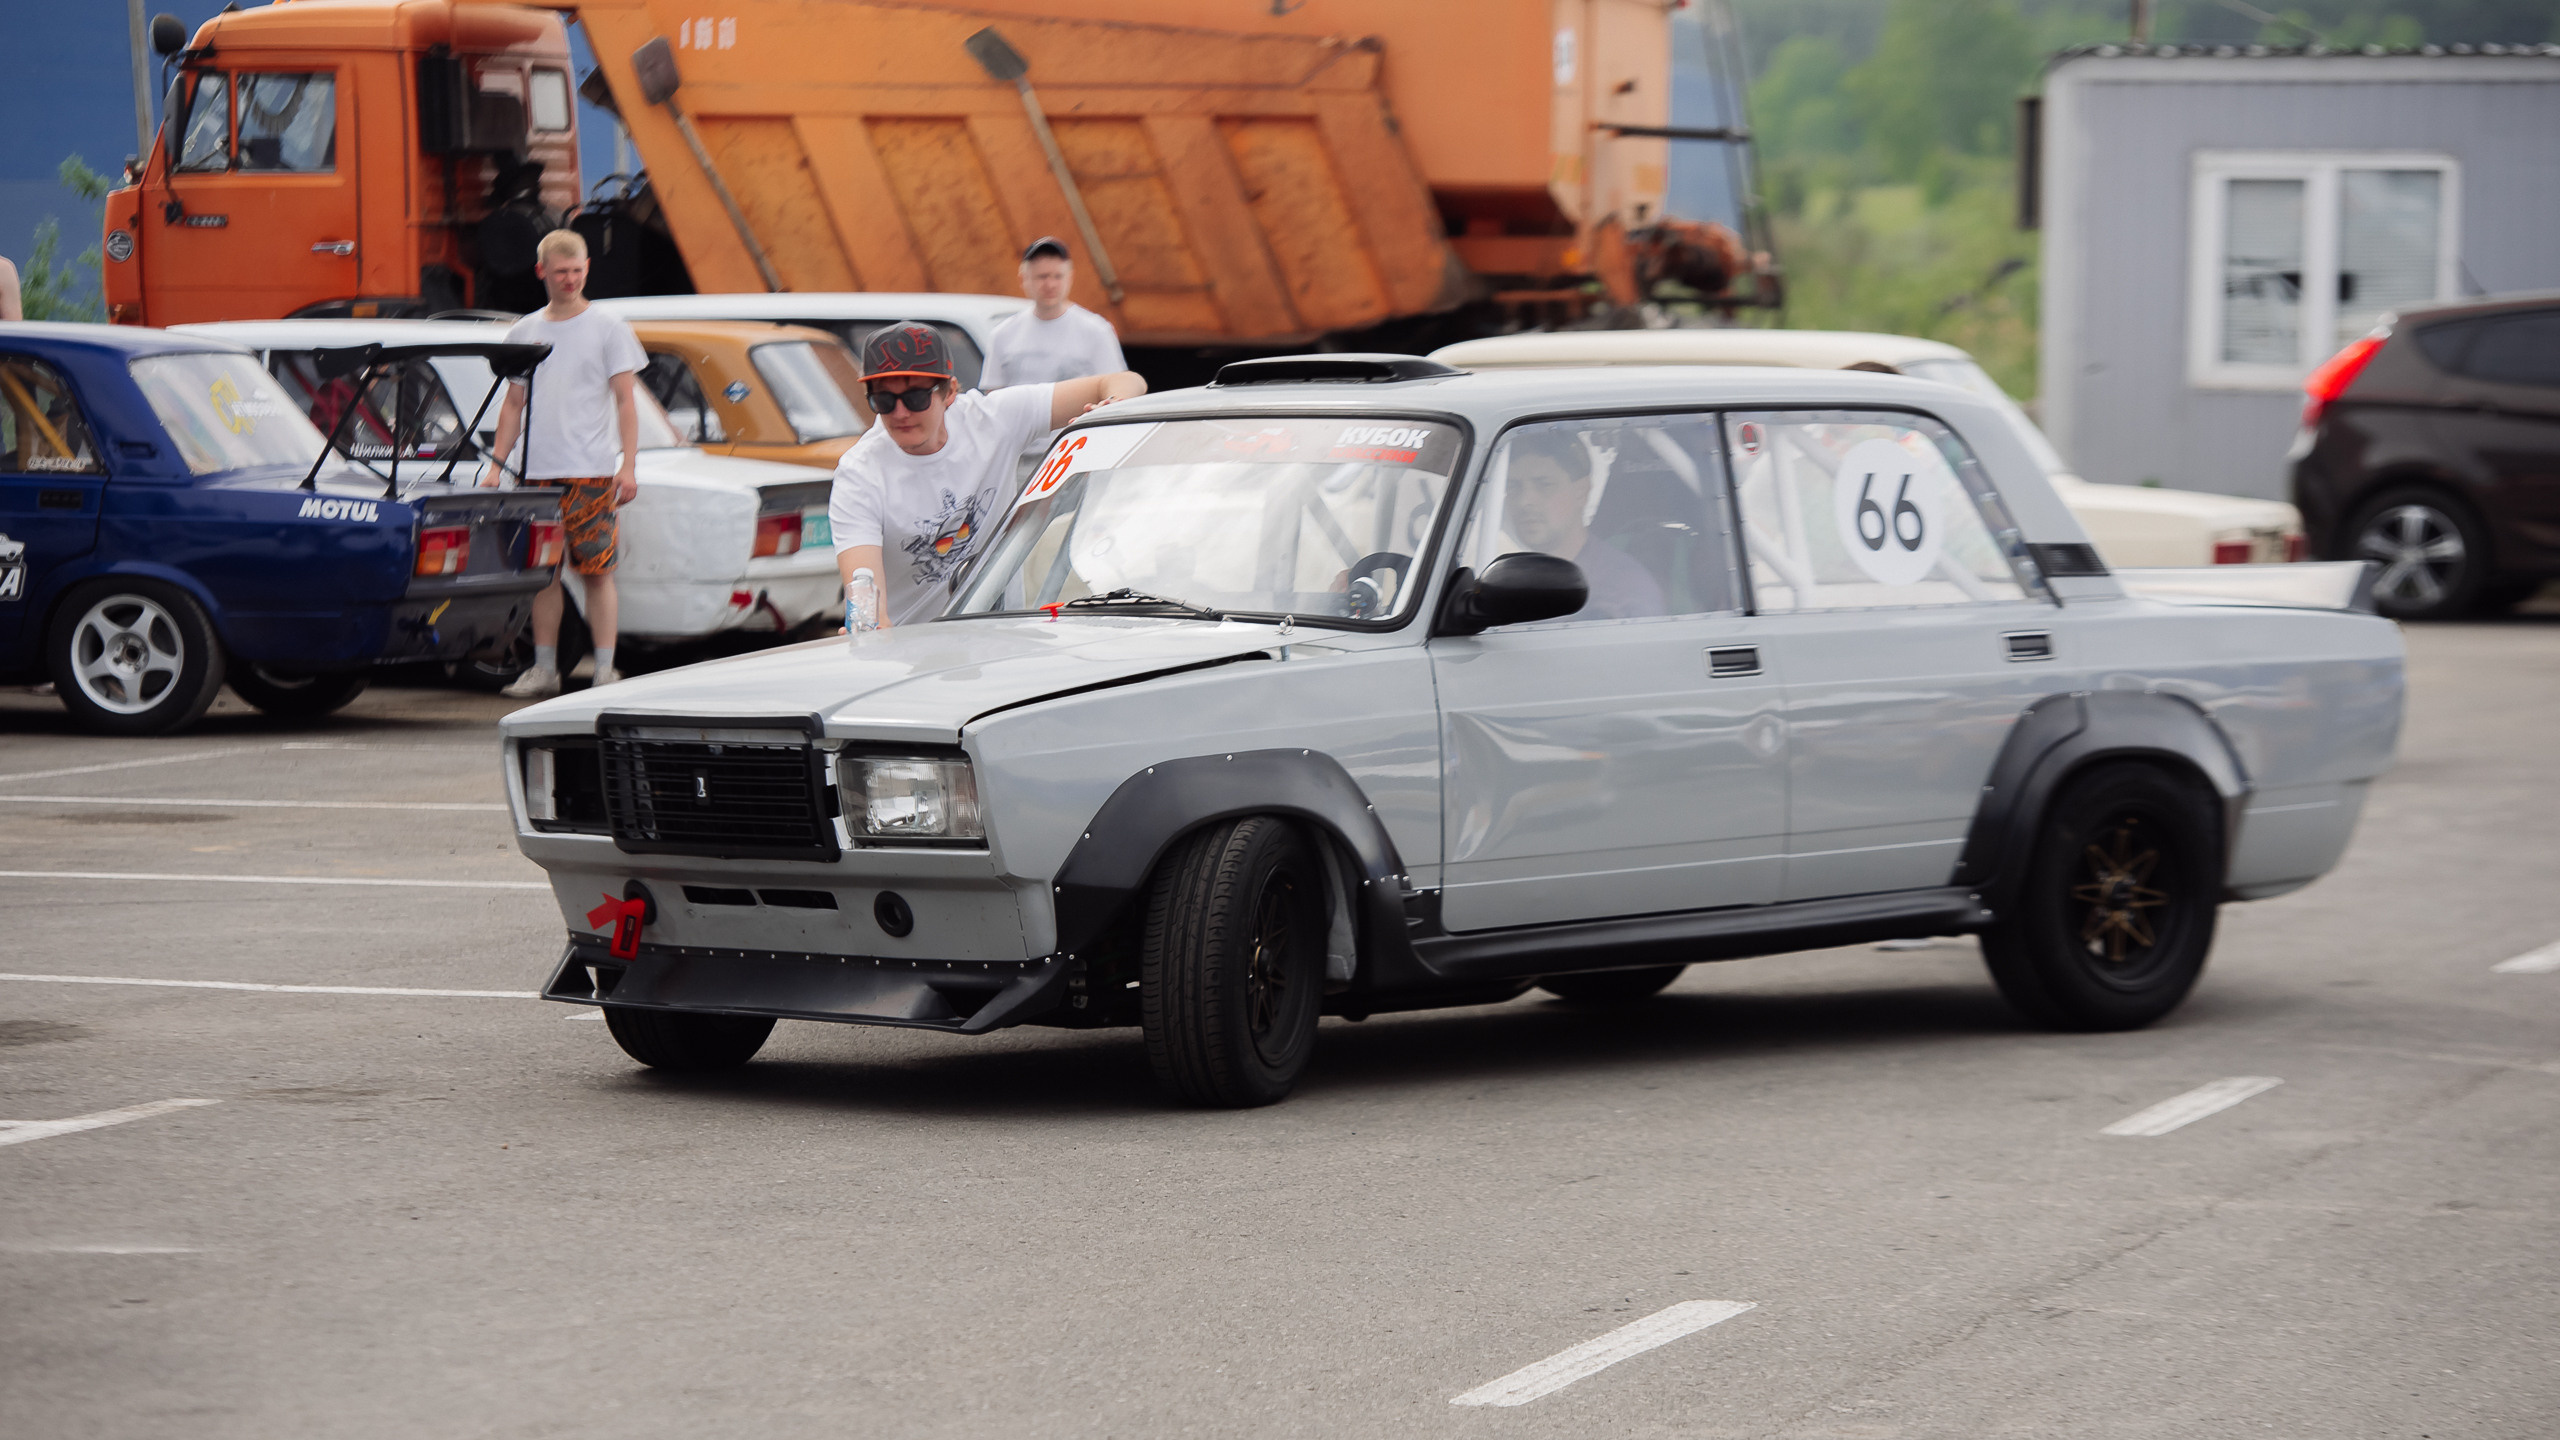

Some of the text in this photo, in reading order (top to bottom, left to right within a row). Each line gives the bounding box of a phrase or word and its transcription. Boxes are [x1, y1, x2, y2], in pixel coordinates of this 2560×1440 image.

[1335, 426, 1432, 450] КУБОК
[1025, 436, 1088, 496] 66
[298, 497, 379, 522] MOTUL
[1857, 472, 1923, 552] 66
